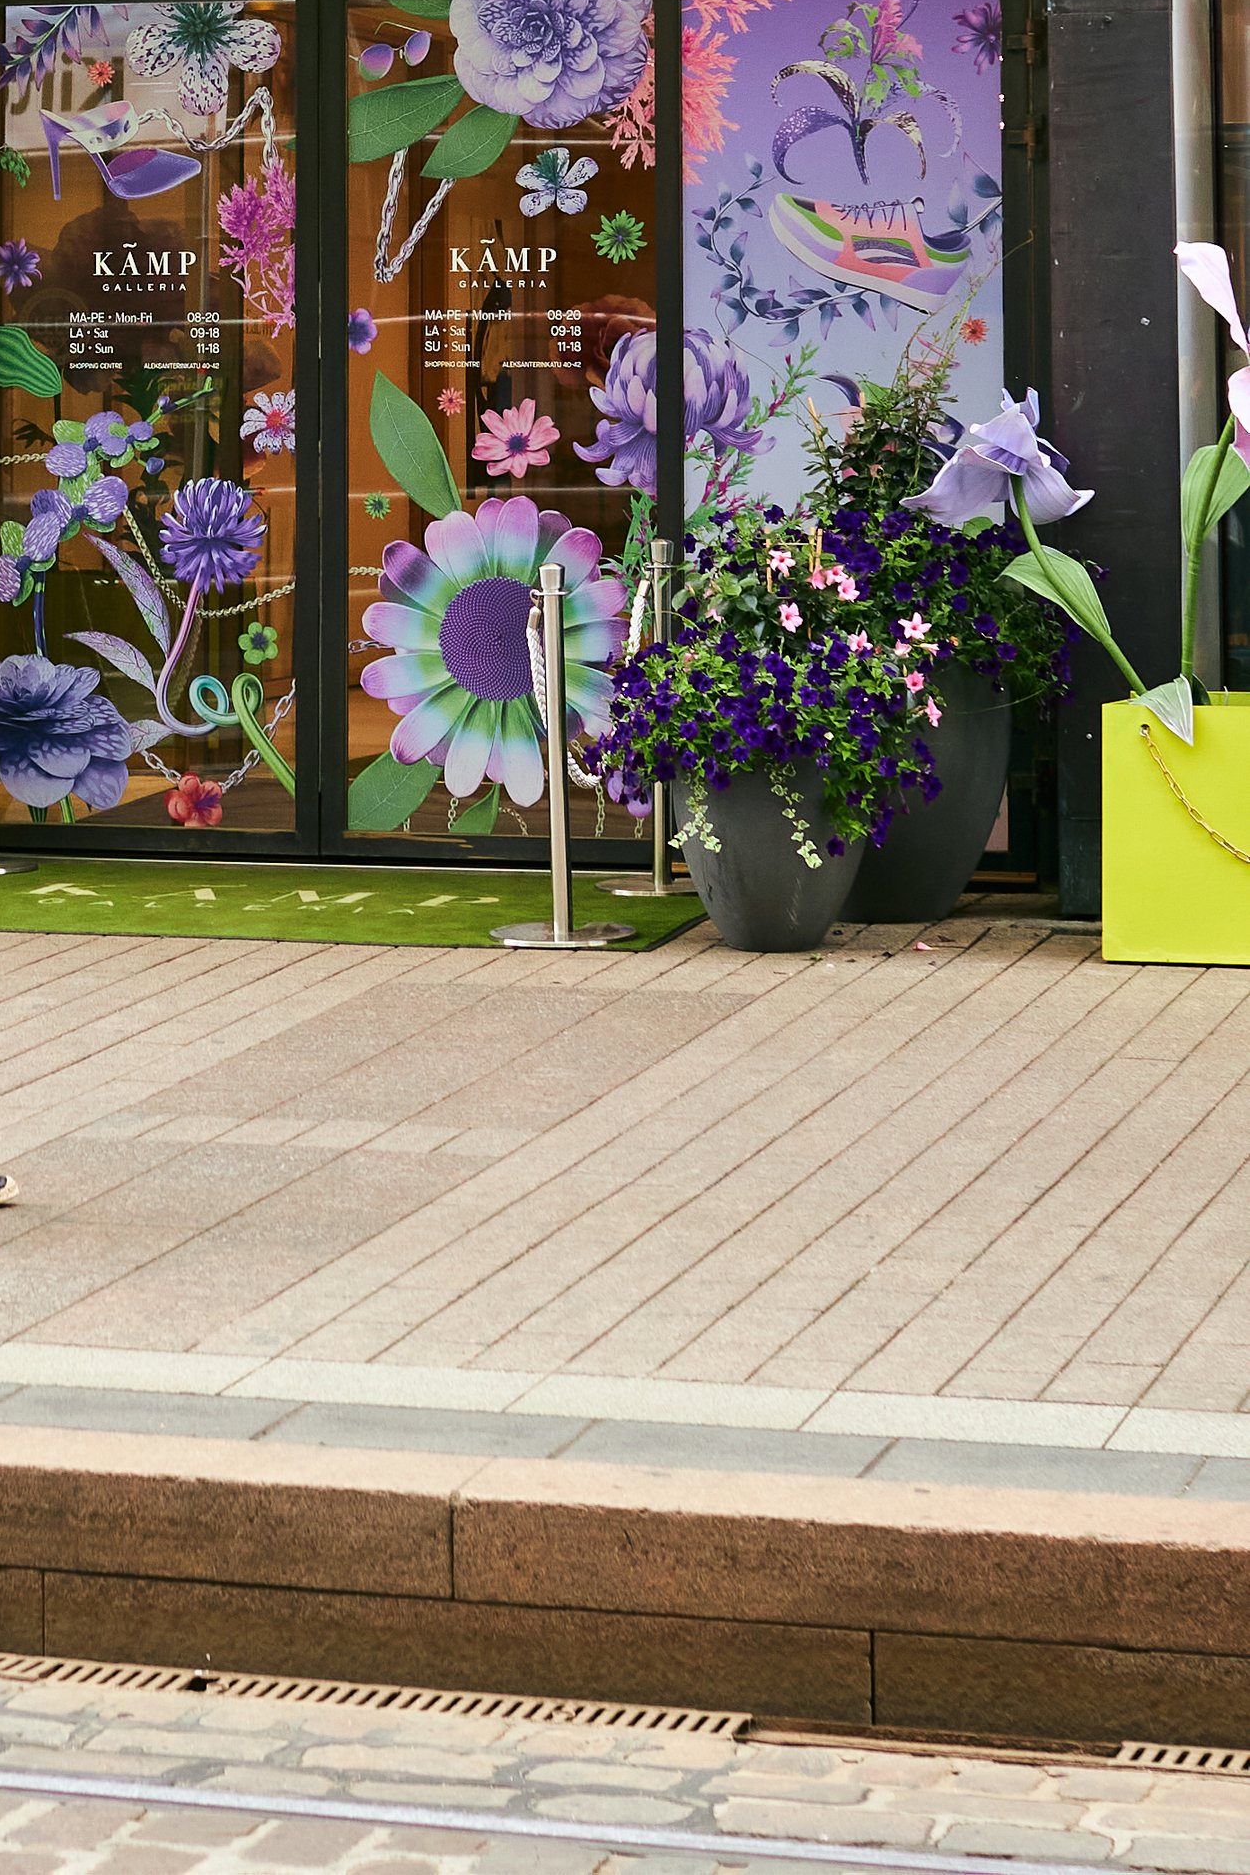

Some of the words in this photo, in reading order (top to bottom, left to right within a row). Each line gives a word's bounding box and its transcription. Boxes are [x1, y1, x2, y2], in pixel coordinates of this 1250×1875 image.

[102, 282, 188, 292] GALLERIA
[458, 279, 548, 288] GALLERIA
[69, 312, 105, 323] MA-PE
[115, 311, 153, 323] Mon-Fri
[186, 312, 220, 323] 08-20
[424, 309, 462, 321] MA-PE
[472, 309, 512, 321] Mon-Fri
[547, 309, 581, 321] 08-20
[69, 328, 84, 339] LA
[93, 327, 109, 339] Sat
[189, 328, 220, 339] 09-18
[424, 325, 440, 337] LA
[449, 325, 466, 337] Sat
[550, 325, 582, 337] 09-18
[69, 343, 85, 354] SU
[94, 343, 114, 354] Sun
[196, 343, 220, 354] 11-18
[424, 341, 441, 353] SU
[451, 341, 471, 353] Sun
[557, 341, 582, 353] 11-18
[69, 362, 99, 370] SHOPPING
[99, 362, 123, 370] CENTRE
[424, 360, 456, 368] SHOPPING
[456, 360, 480, 368] CENTRE
[502, 360, 562, 368] ALEKSANTERINKATU
[562, 360, 582, 368] 40-42
